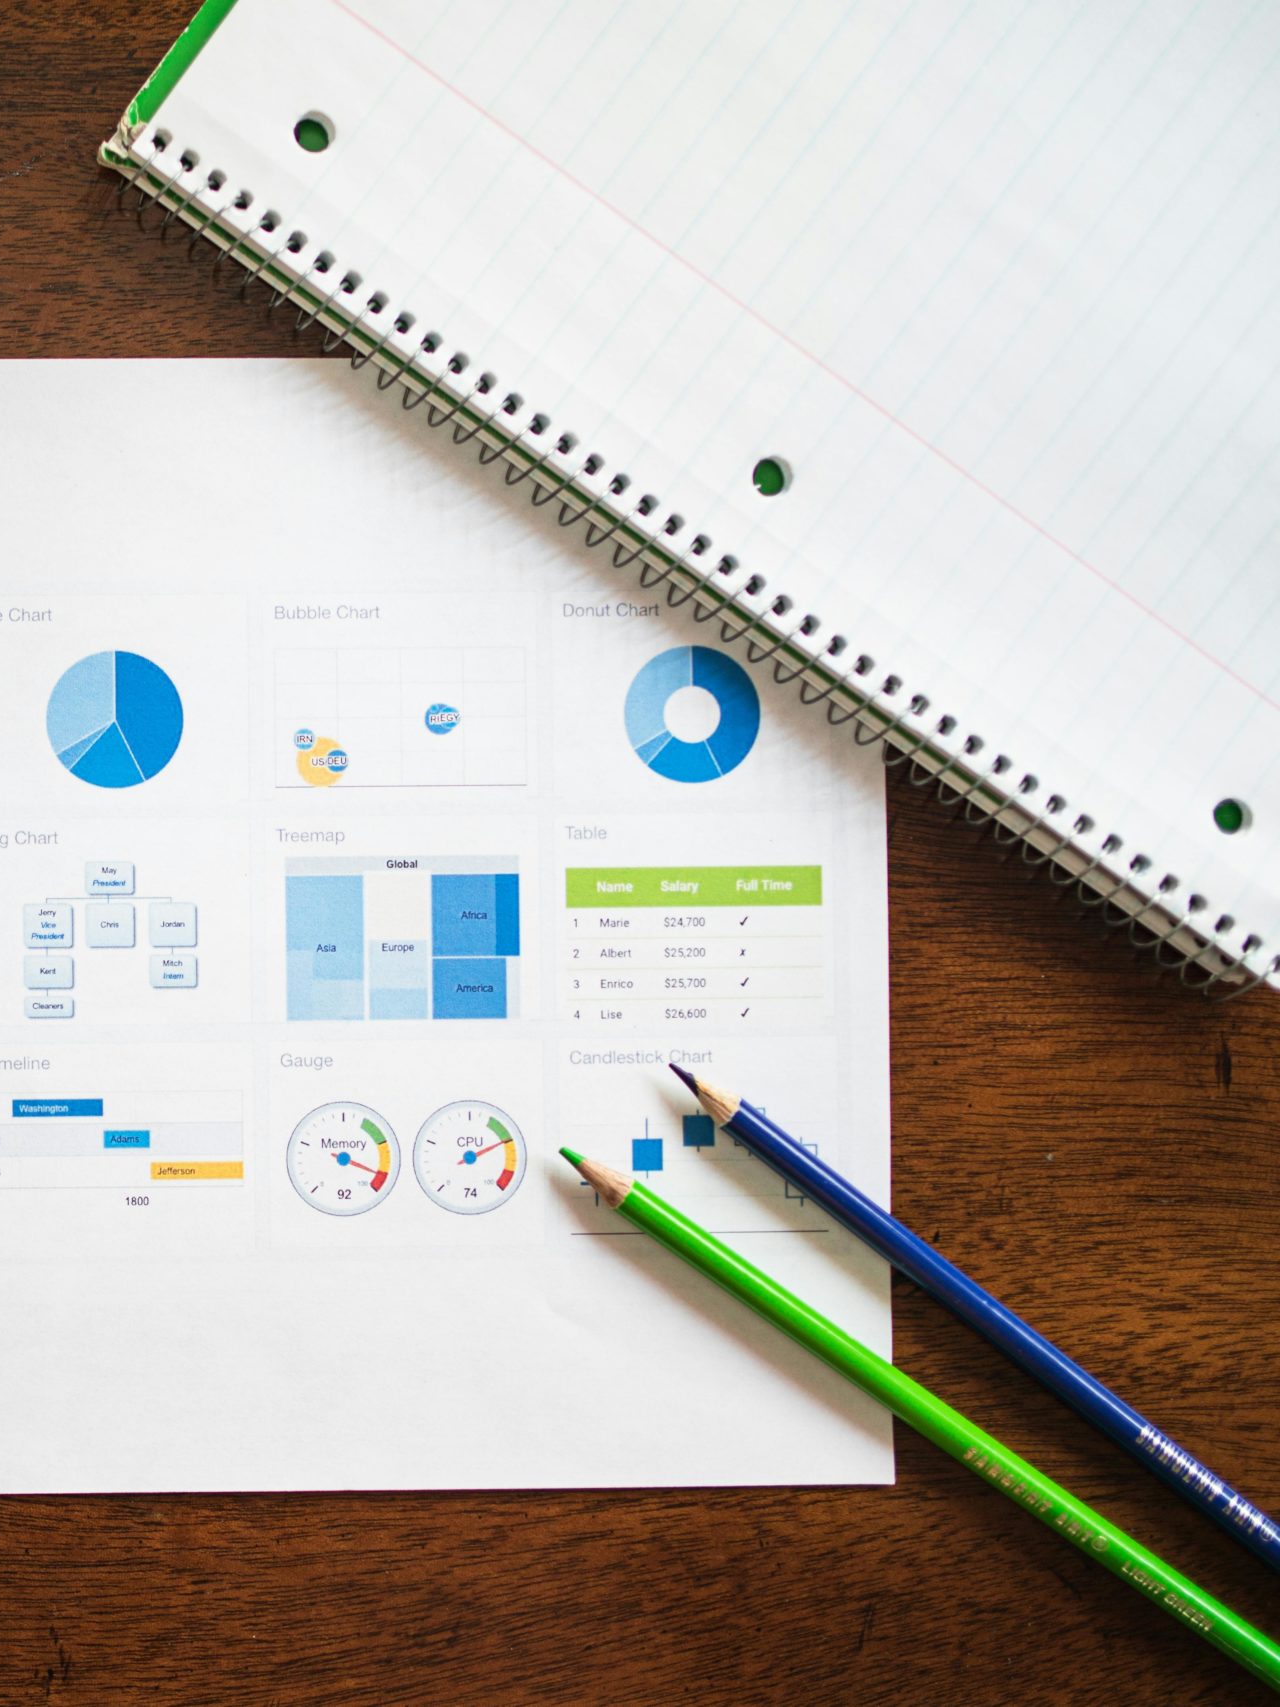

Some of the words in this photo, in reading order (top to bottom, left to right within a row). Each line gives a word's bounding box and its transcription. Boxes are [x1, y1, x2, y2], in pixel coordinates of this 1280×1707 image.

[274, 605, 332, 620] Bubble
[336, 605, 380, 620] Chart
[563, 603, 612, 618] Donut
[617, 601, 660, 617] Chart
[8, 608, 52, 623] Chart
[14, 830, 58, 845] Chart
[276, 829, 345, 845] Treemap
[565, 825, 607, 840] Table
[386, 859, 418, 869] Global
[101, 866, 117, 875] May
[92, 879, 126, 887] President
[596, 881, 633, 893] Name
[661, 880, 699, 894] Salary
[736, 879, 757, 891] Full
[761, 878, 794, 891] Time
[461, 910, 488, 920] Africa
[40, 921, 57, 929] Vice
[100, 920, 120, 928] Chris
[160, 920, 186, 928] Jordan
[599, 917, 630, 928] Marie
[663, 916, 706, 929] $24,700
[31, 932, 64, 940] President
[317, 943, 336, 953] Asia
[381, 943, 415, 954] Europe
[573, 948, 580, 959] 2
[599, 948, 632, 959] Albert
[664, 946, 707, 960] $25,200
[456, 983, 494, 993] America
[573, 979, 580, 989] 3
[599, 978, 634, 989] Enrico
[664, 977, 707, 990] $25,700
[32, 1002, 64, 1010] Cleaners
[573, 1010, 581, 1020] 4
[600, 1009, 623, 1020] Lise
[664, 1008, 707, 1020] $26,600
[280, 1053, 333, 1071] Gauge
[569, 1050, 664, 1065] Candlestick
[669, 1050, 713, 1064] Chart
[19, 1103, 69, 1116] Washington
[110, 1134, 140, 1145] Adams
[321, 1139, 367, 1150] Memory
[457, 1137, 483, 1147] CPU
[157, 1166, 196, 1178] Jefferson
[337, 1189, 351, 1199] 92
[464, 1188, 477, 1198] 74
[125, 1196, 150, 1207] 1800
